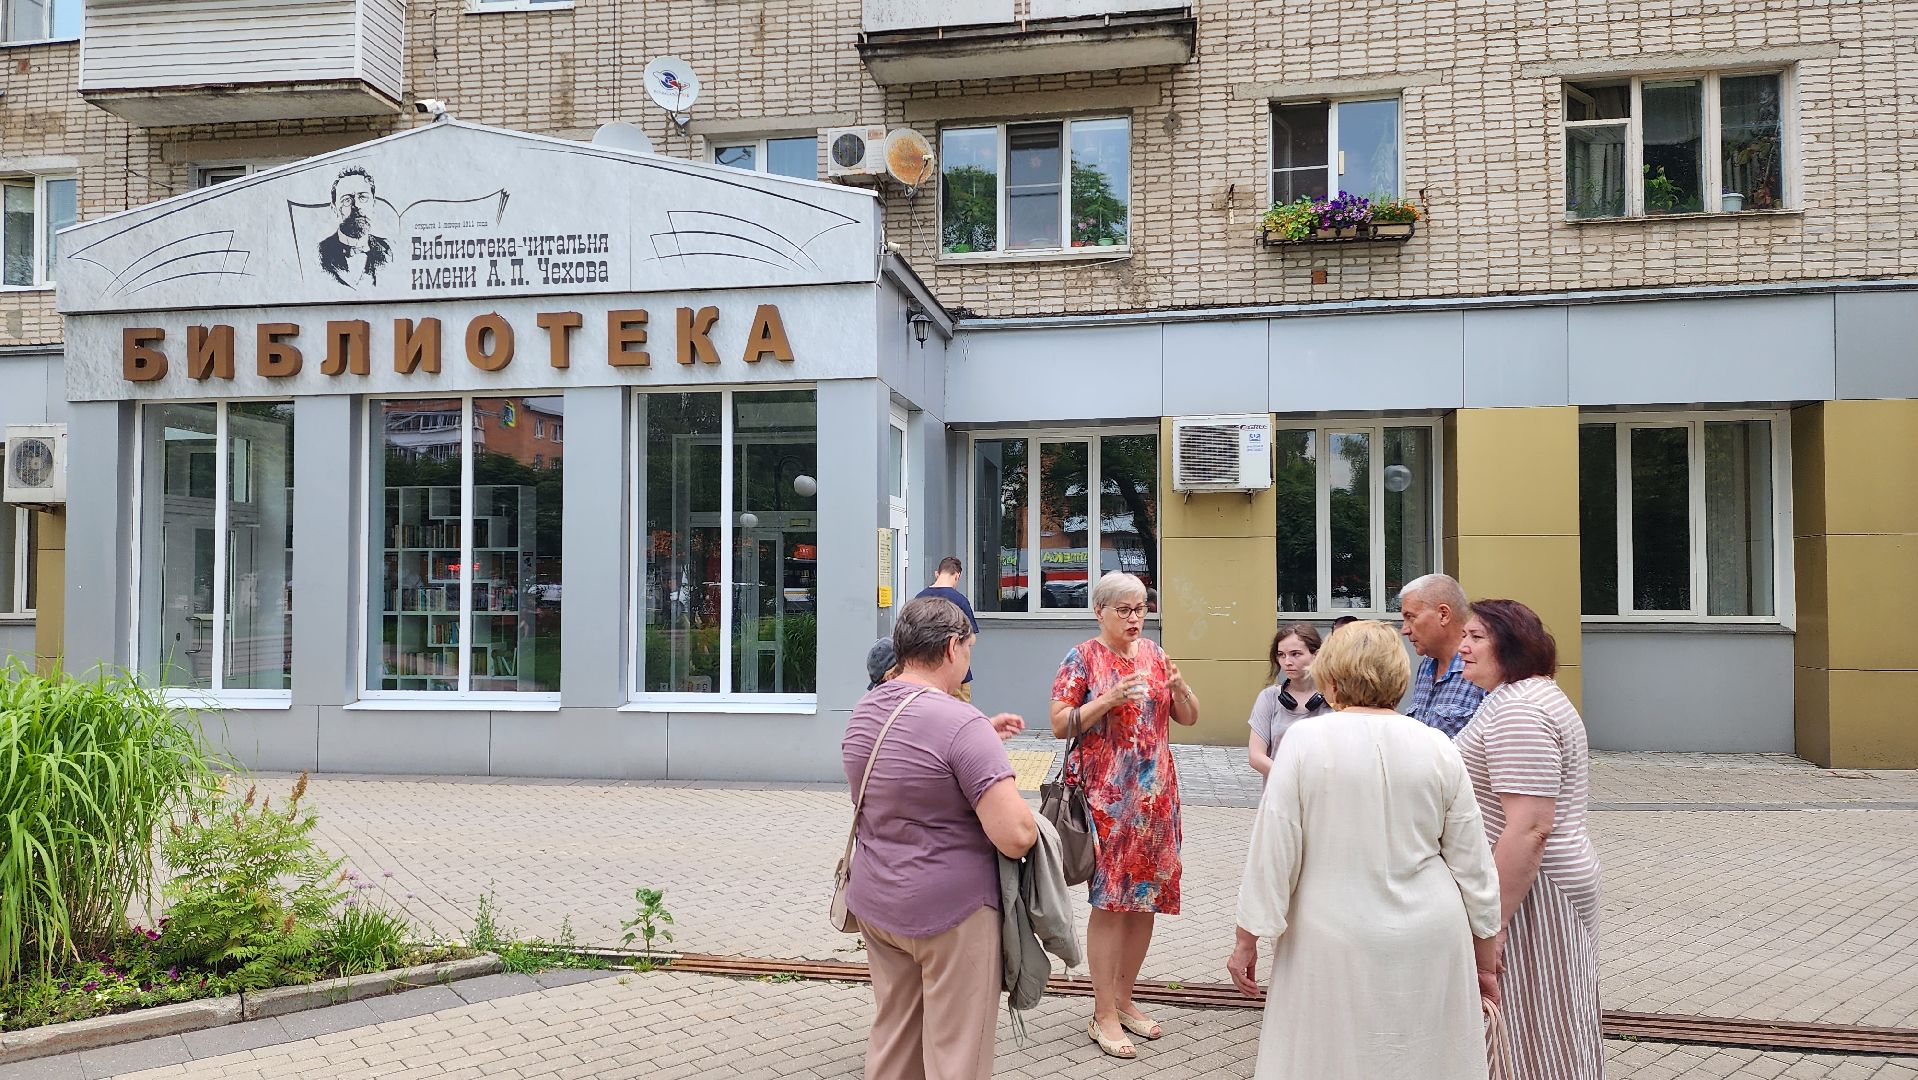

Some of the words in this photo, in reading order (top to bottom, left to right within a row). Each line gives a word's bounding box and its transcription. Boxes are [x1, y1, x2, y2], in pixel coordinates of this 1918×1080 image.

[411, 233, 609, 261] Библиотека-читальня
[411, 265, 477, 290] имени
[537, 257, 609, 285] Чехова
[122, 303, 794, 383] БИБЛИОТЕКА
